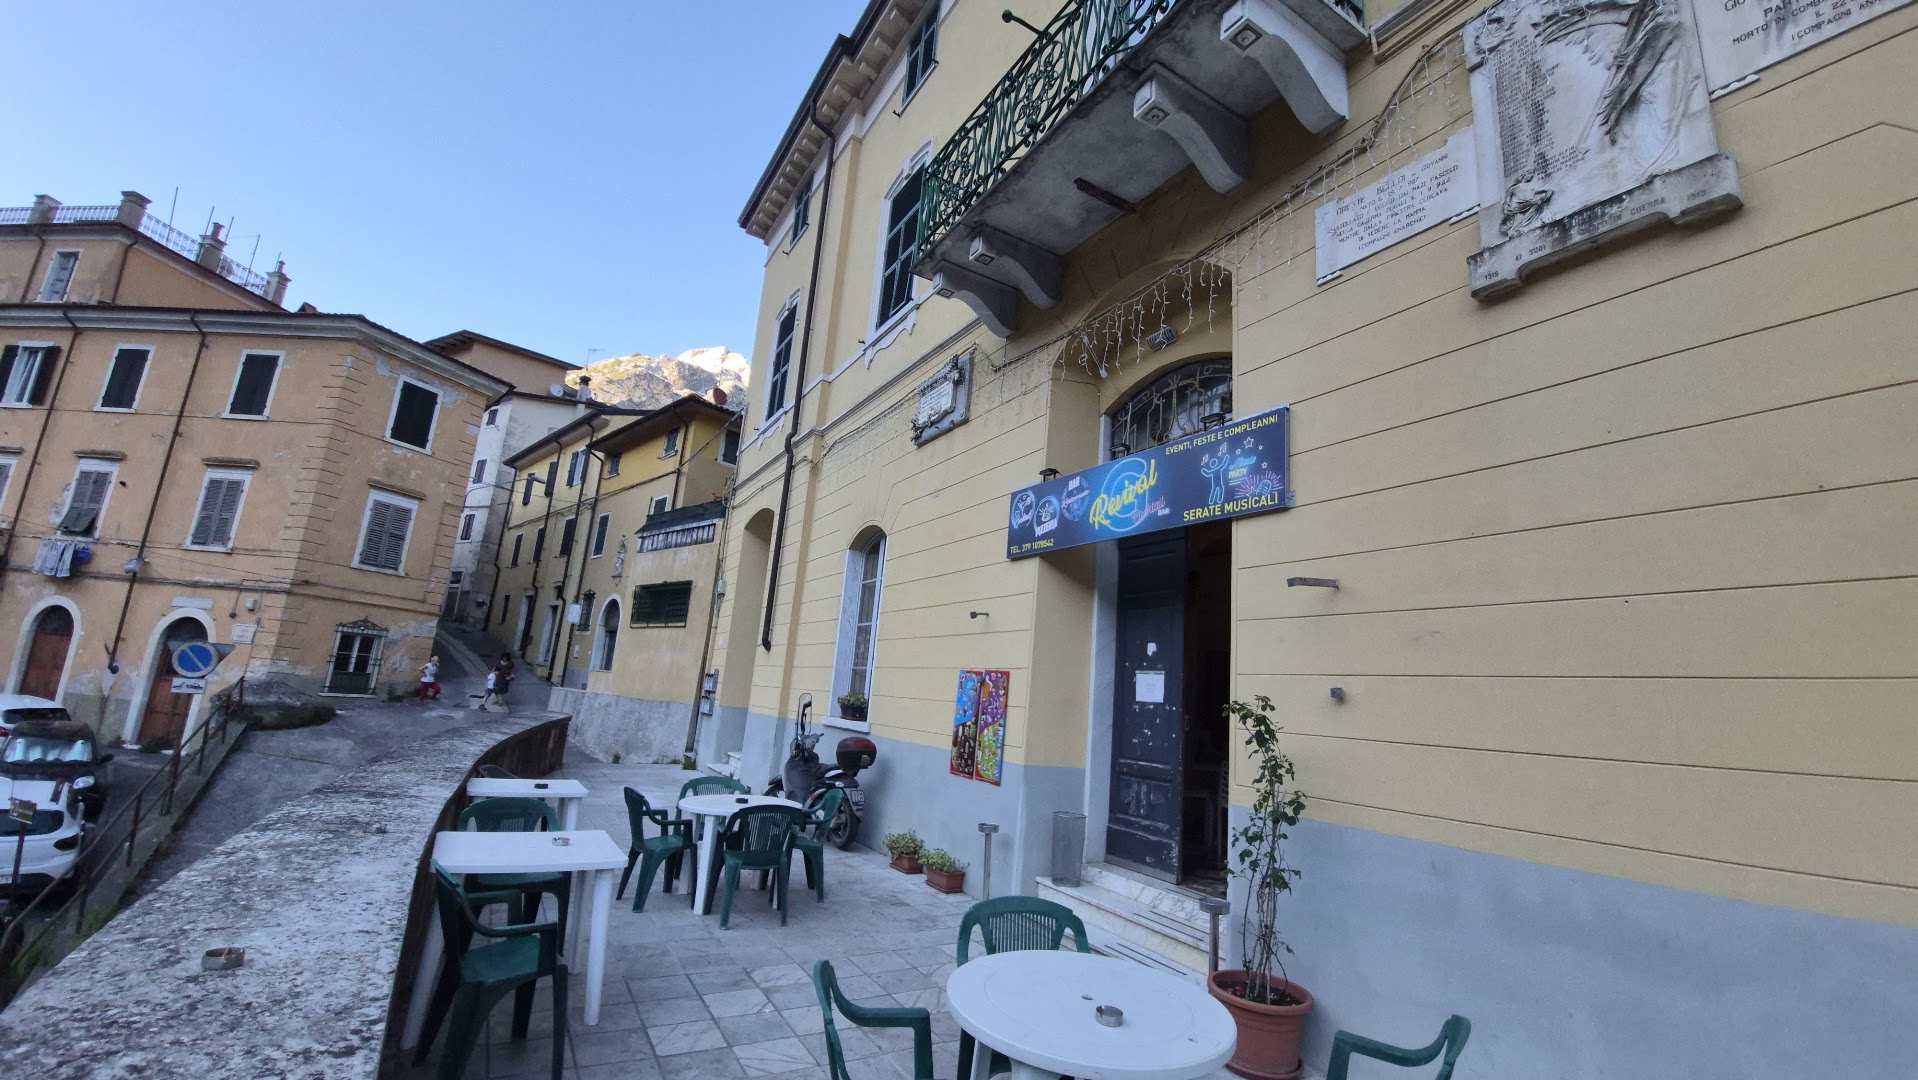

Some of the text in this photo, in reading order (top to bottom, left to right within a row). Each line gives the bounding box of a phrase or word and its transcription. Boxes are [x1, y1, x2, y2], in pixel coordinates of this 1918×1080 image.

[1815, 9, 1825, 18] IL
[1732, 23, 1769, 46] MORTO
[1774, 16, 1785, 26] IN
[1796, 8, 1852, 39] COMPAGNI
[1412, 181, 1425, 192] NAZI
[1429, 163, 1458, 183] FASCISTI
[1418, 186, 1447, 205] CERCAVA
[1405, 205, 1425, 219] MAMMA
[1529, 244, 1546, 257] SUOI
[1165, 414, 1278, 455] EVENTI, FESTE E COMPLEANNI
[1229, 467, 1248, 478] PARTY
[1089, 459, 1158, 530] Revival
[1157, 507, 1170, 516] BAR
[1183, 491, 1278, 521] SERATE MUSICALI
[1010, 545, 1020, 554] TEL.
